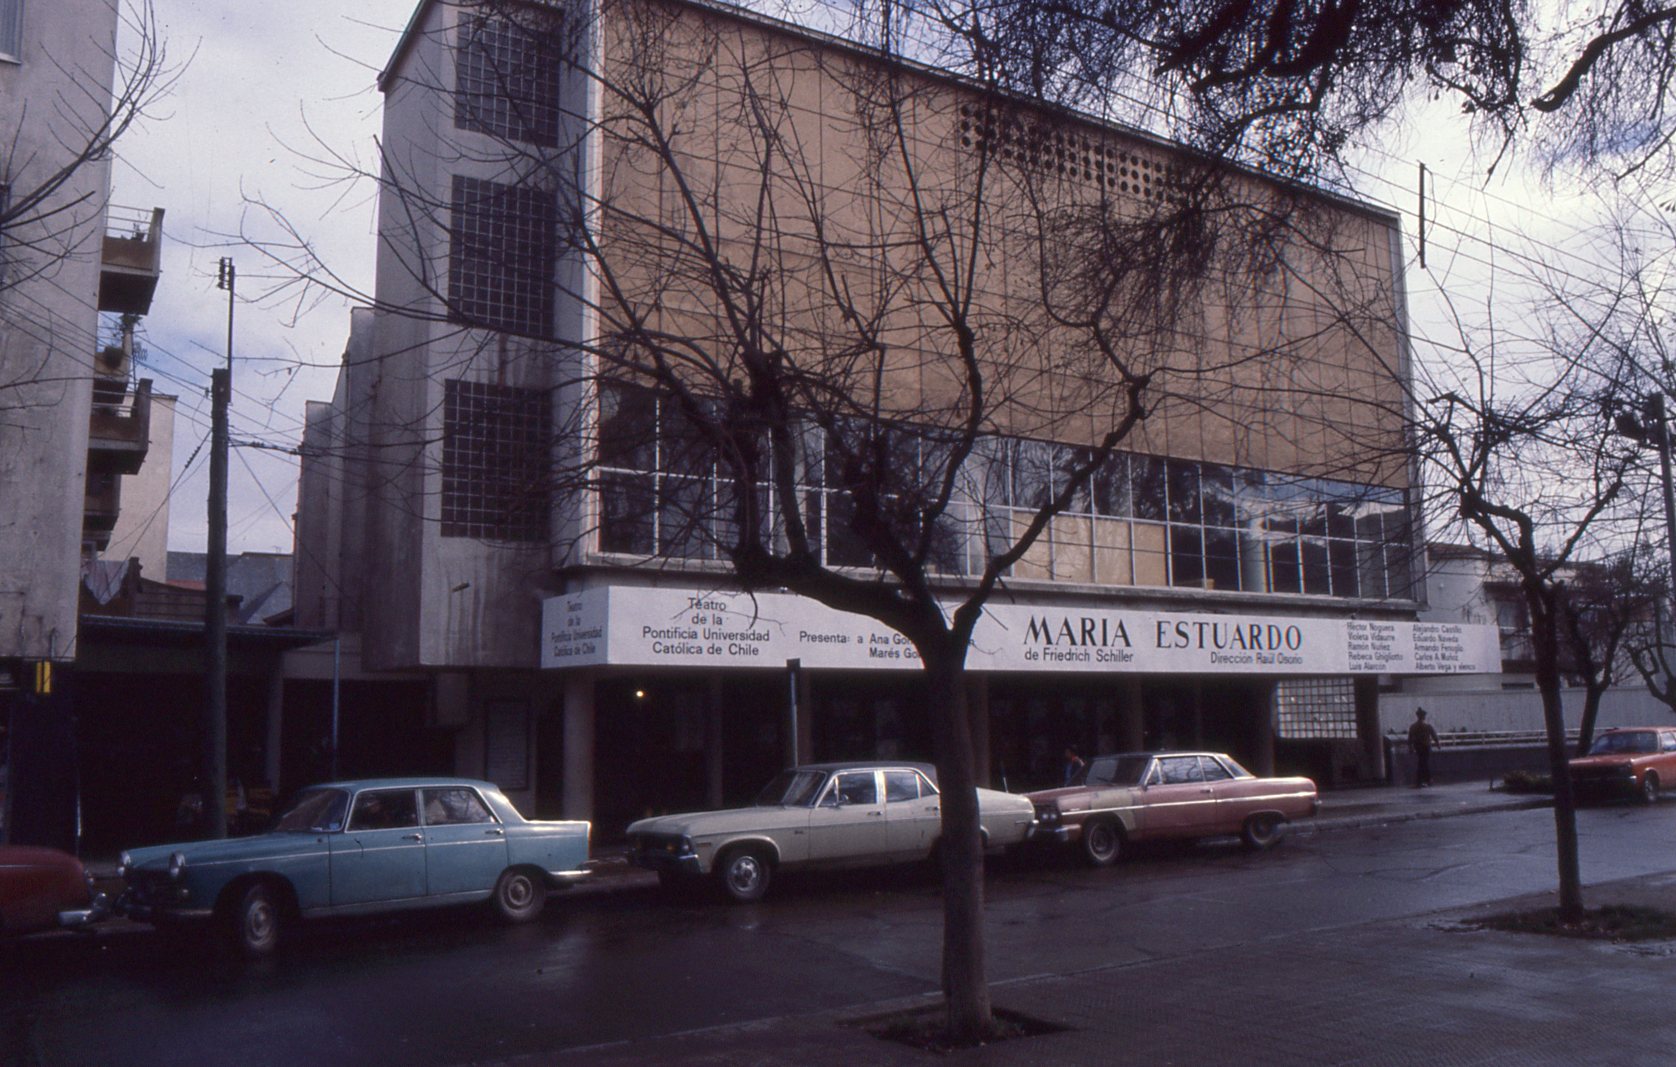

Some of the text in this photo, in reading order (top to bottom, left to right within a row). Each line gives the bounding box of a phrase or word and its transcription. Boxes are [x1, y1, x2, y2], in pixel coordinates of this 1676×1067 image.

[567, 600, 583, 612] Teatro
[688, 597, 726, 611] Teatro
[691, 613, 723, 625] de la
[1023, 615, 1302, 651] MARIA ESTUARDO
[1369, 622, 1394, 633] Noguera
[1412, 624, 1462, 635] Alejandro Castillo
[551, 626, 602, 646] Pontificia Universidad
[642, 626, 770, 642] Pontificia Universidad
[799, 630, 850, 643] Presenta:
[857, 635, 864, 644] a
[869, 632, 889, 645] Ana
[1347, 631, 1395, 641] Violeta Vidaurre
[1412, 633, 1459, 642] Eduardo Naveda
[582, 641, 596, 654] Chile
[652, 641, 759, 655] Católica de Chile
[869, 647, 900, 659] Marés
[1414, 643, 1439, 651] Armando
[1024, 647, 1134, 662] de Friedrich Schiller
[1210, 651, 1252, 664] Dirección
[1277, 652, 1303, 665] Osorio
[1348, 651, 1373, 660] Rebeca
[1415, 652, 1433, 661] Carlos
[1349, 661, 1362, 670] Luis
[1416, 661, 1436, 670] Alberto
[1437, 662, 1451, 672] Vega
